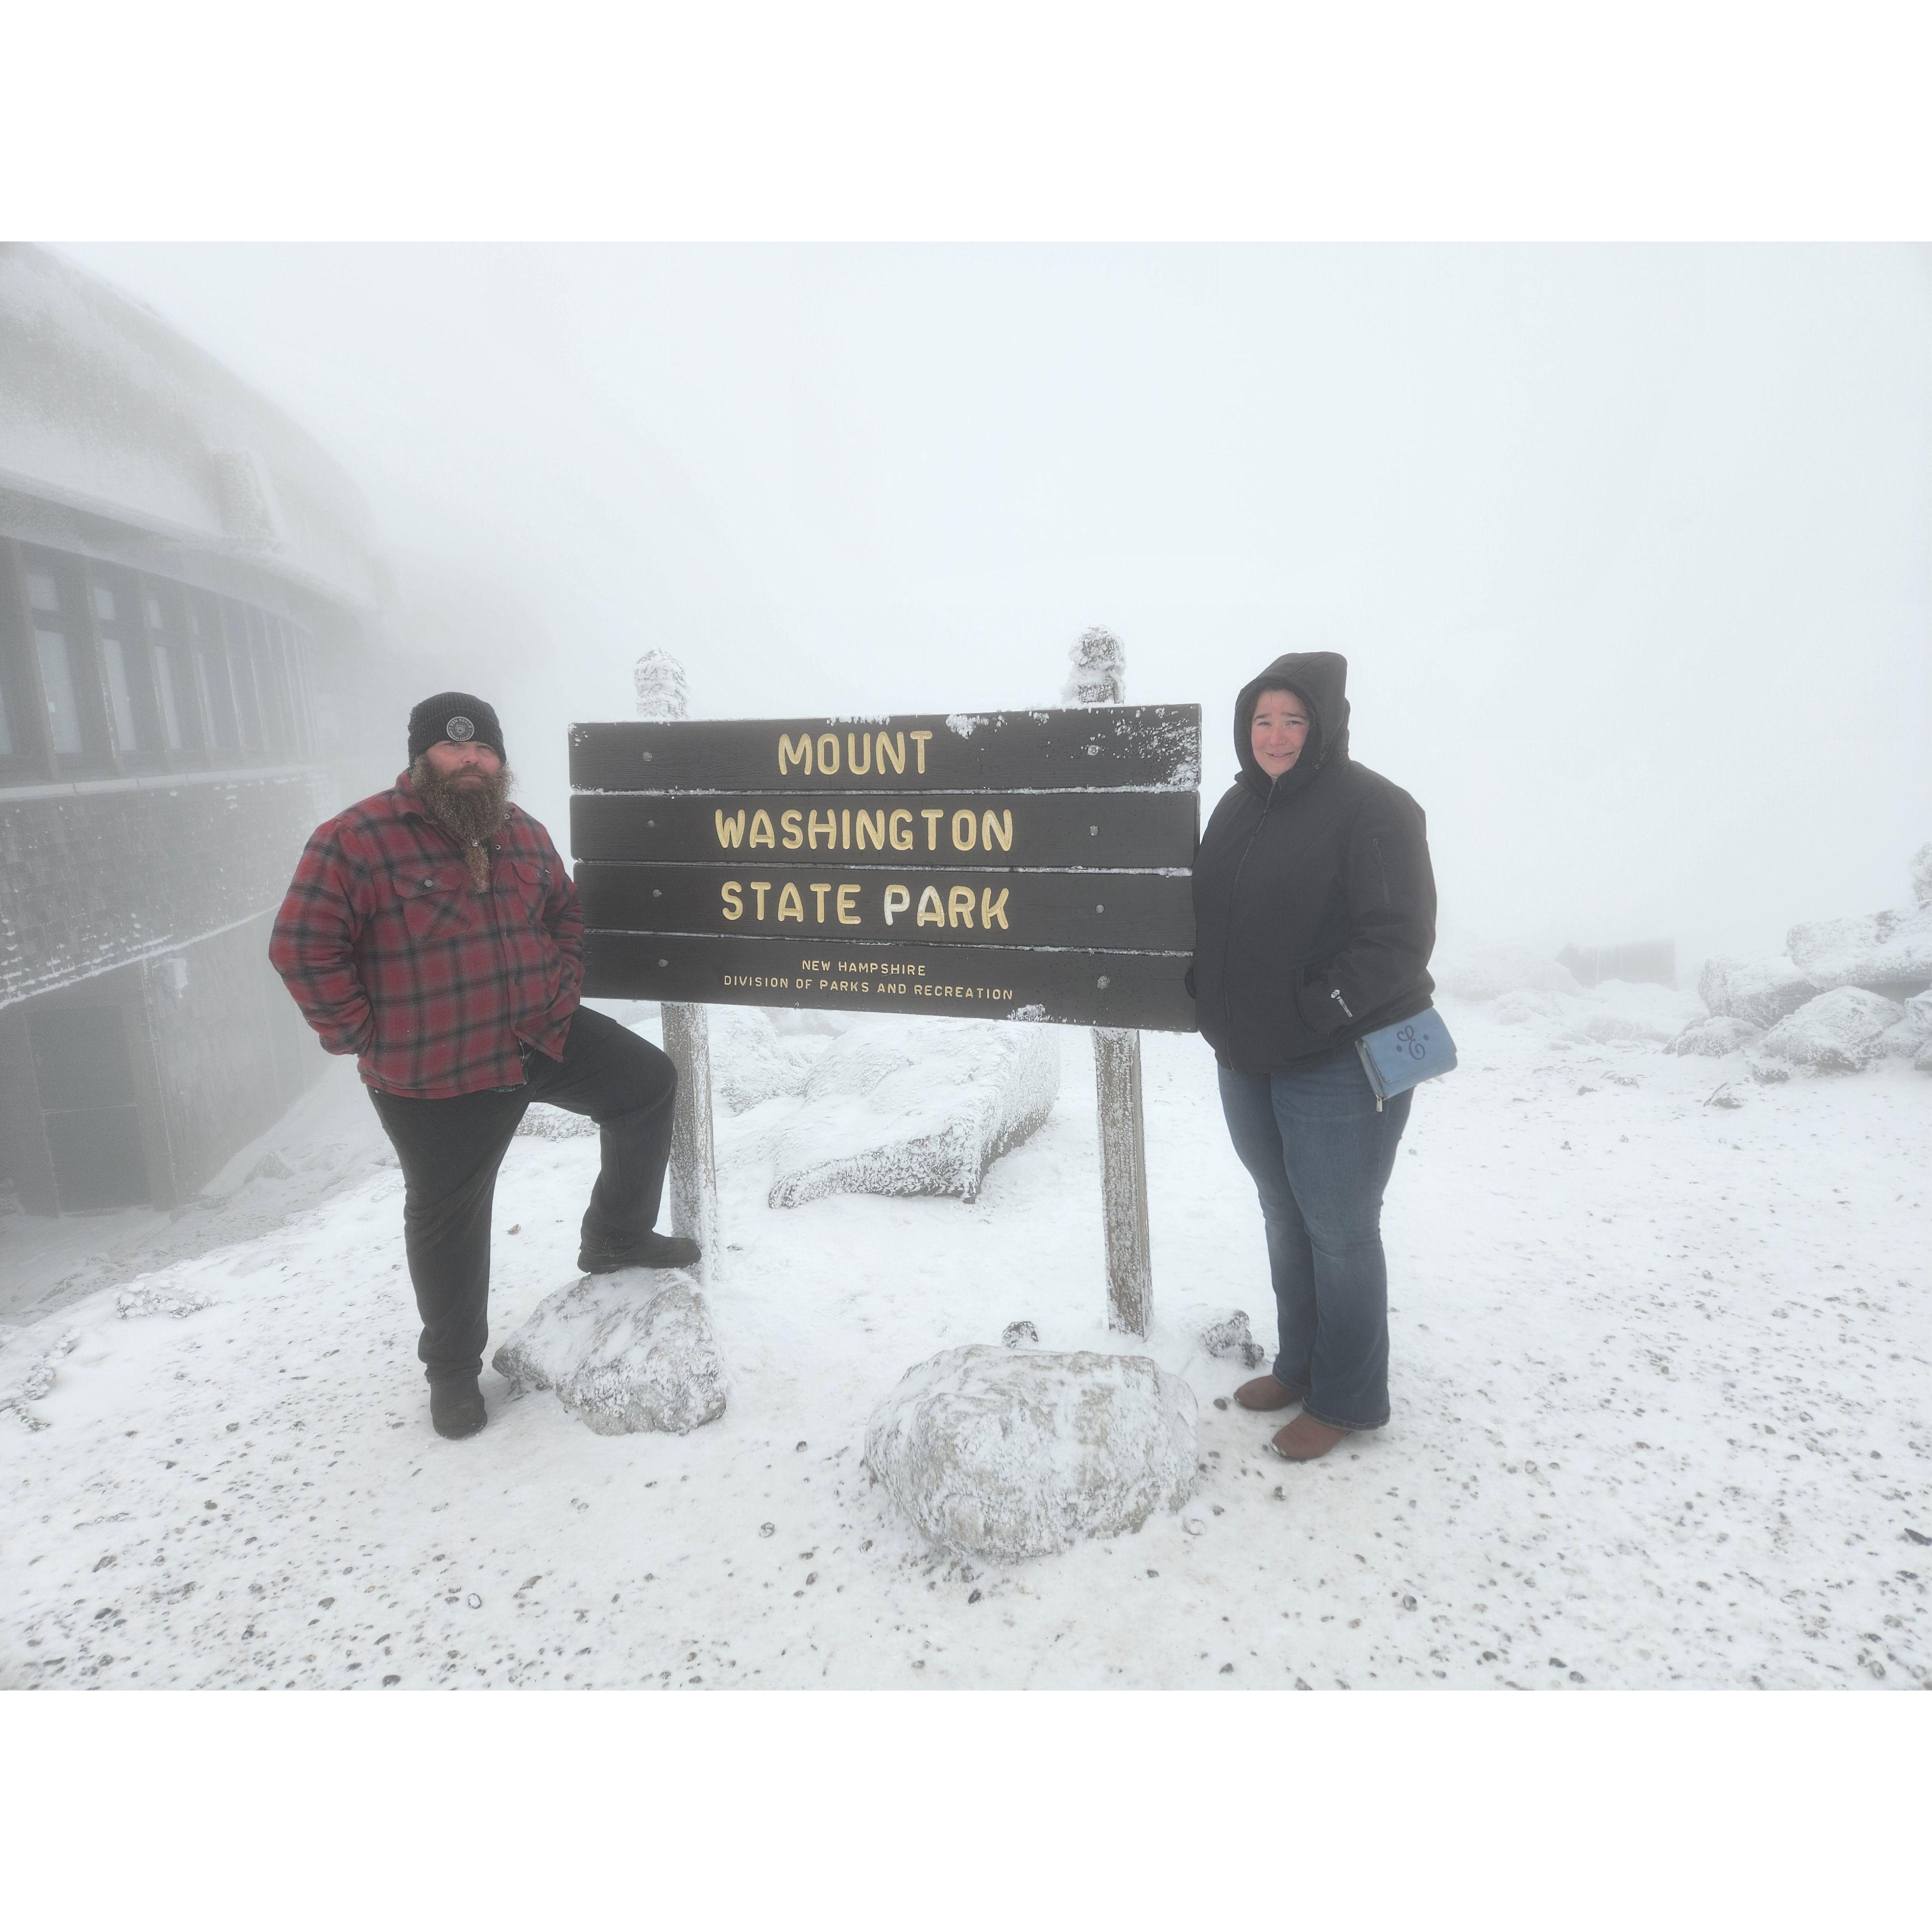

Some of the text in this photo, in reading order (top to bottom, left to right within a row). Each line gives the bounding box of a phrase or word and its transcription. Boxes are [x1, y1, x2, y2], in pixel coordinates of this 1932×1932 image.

[778, 730, 934, 776] MOUNT
[715, 808, 1014, 852] WASHINGTON
[721, 881, 1010, 930] STATE PARK
[724, 976, 1013, 1000] DIVISION OF PARKS AND RECREATION
[802, 960, 926, 976] NEW HAMPSHIRE
